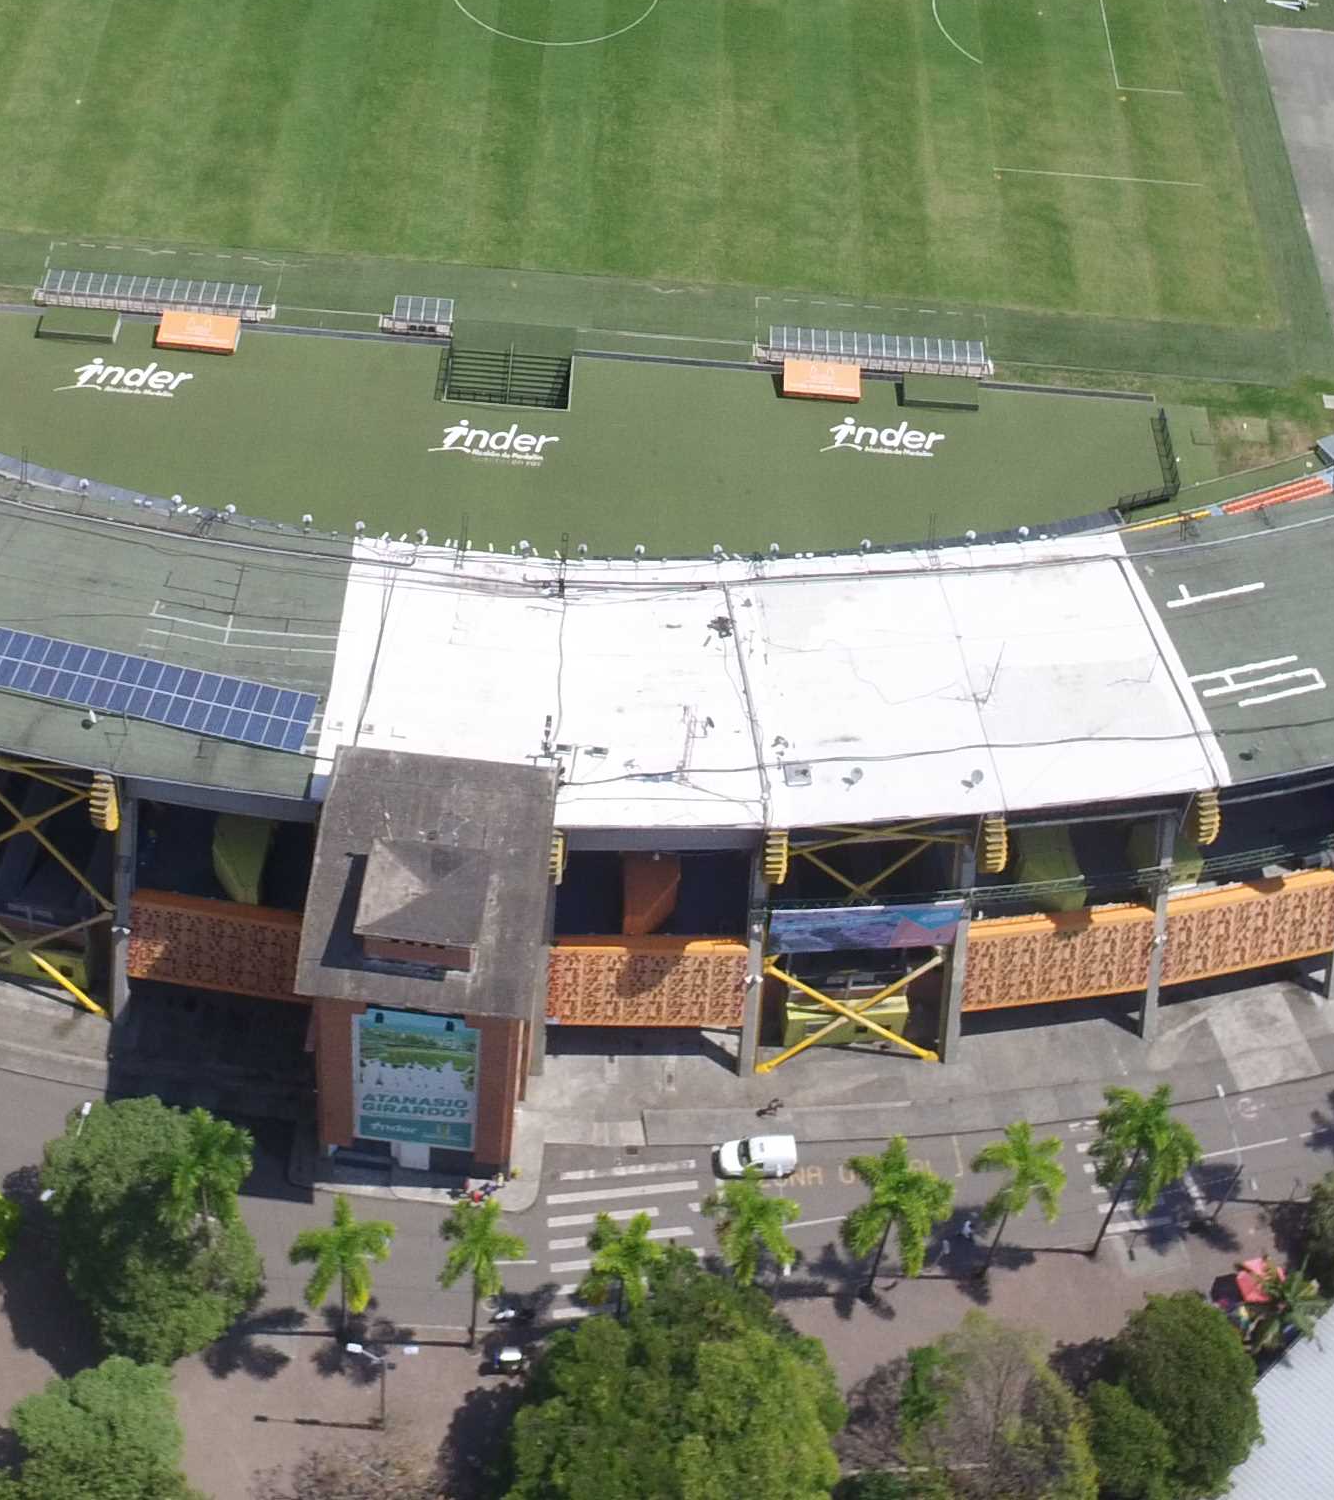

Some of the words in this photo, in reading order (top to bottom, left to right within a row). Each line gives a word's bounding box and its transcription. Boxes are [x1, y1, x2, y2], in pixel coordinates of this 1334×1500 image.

[74, 357, 194, 390] inder
[443, 419, 560, 453] inder
[830, 416, 946, 450] inder
[362, 1093, 468, 1109] ATANASIO
[362, 1101, 469, 1117] GIRARDOT
